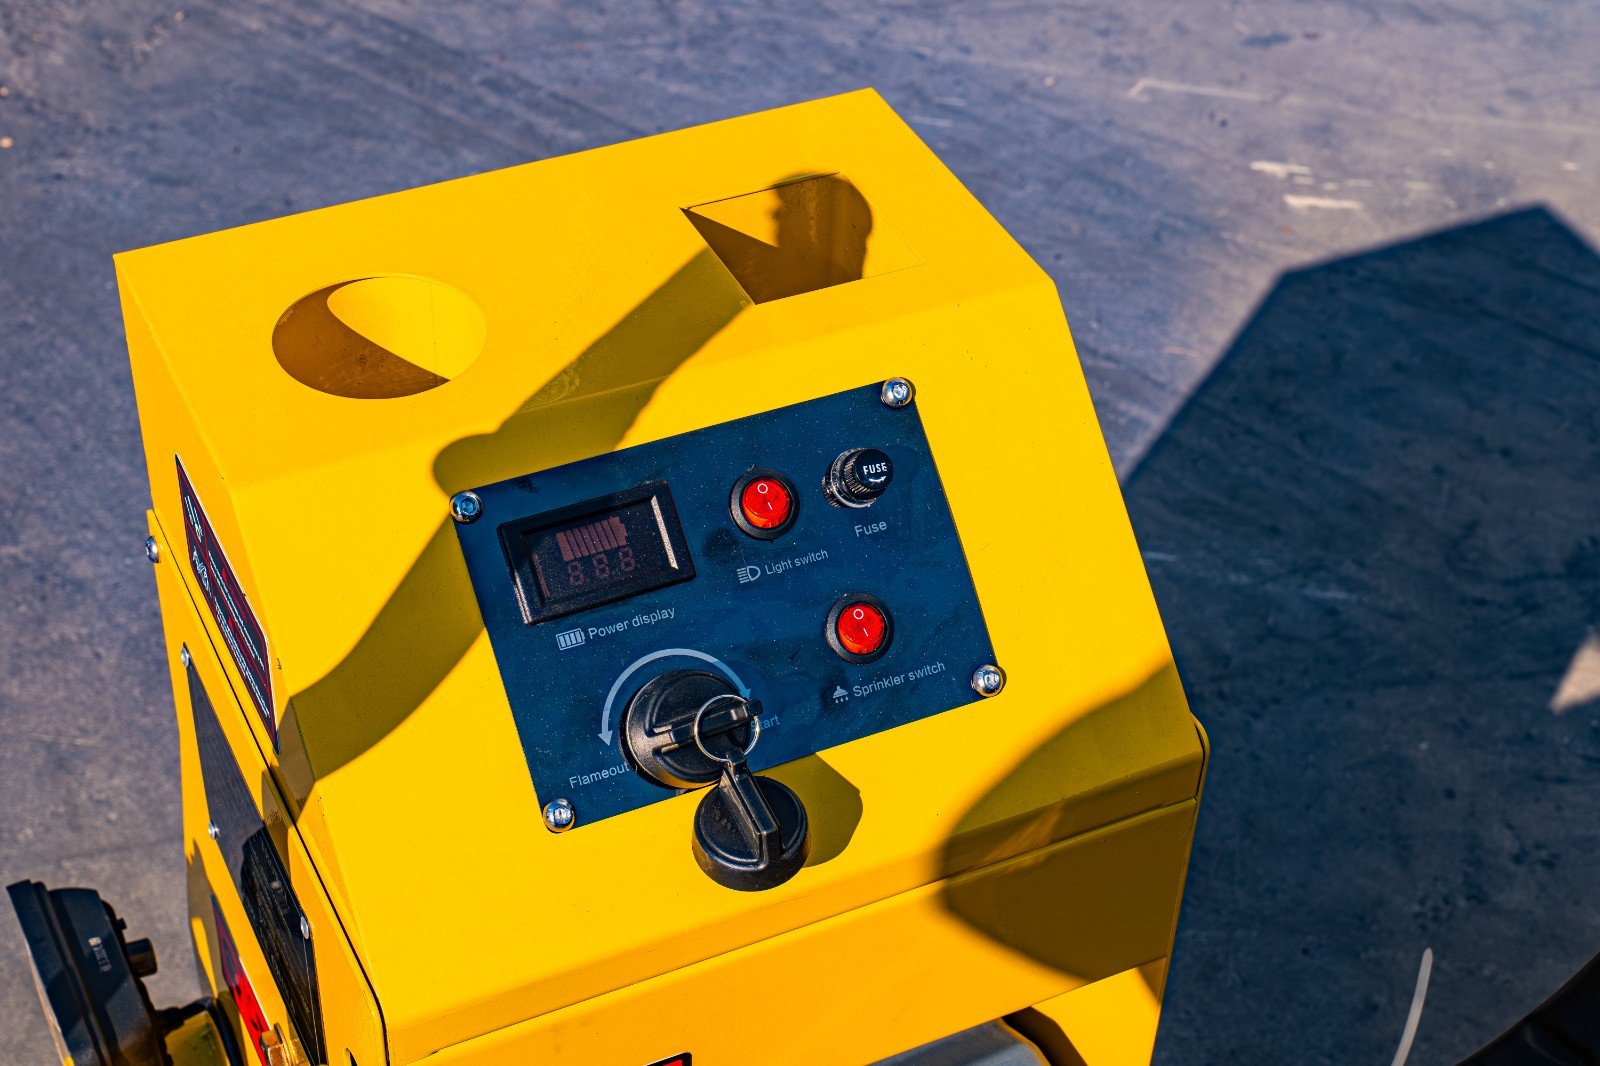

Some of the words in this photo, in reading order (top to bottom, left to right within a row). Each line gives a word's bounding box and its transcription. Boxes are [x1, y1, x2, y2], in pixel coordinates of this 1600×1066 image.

[863, 462, 888, 475] FUSE
[854, 520, 888, 537] Fuse
[765, 556, 793, 575] Light
[794, 549, 829, 567] switch
[588, 619, 630, 640] Power
[632, 607, 675, 628] display
[852, 673, 906, 698] Sprinkler
[908, 661, 946, 681] switch
[568, 761, 630, 789] Flameout
